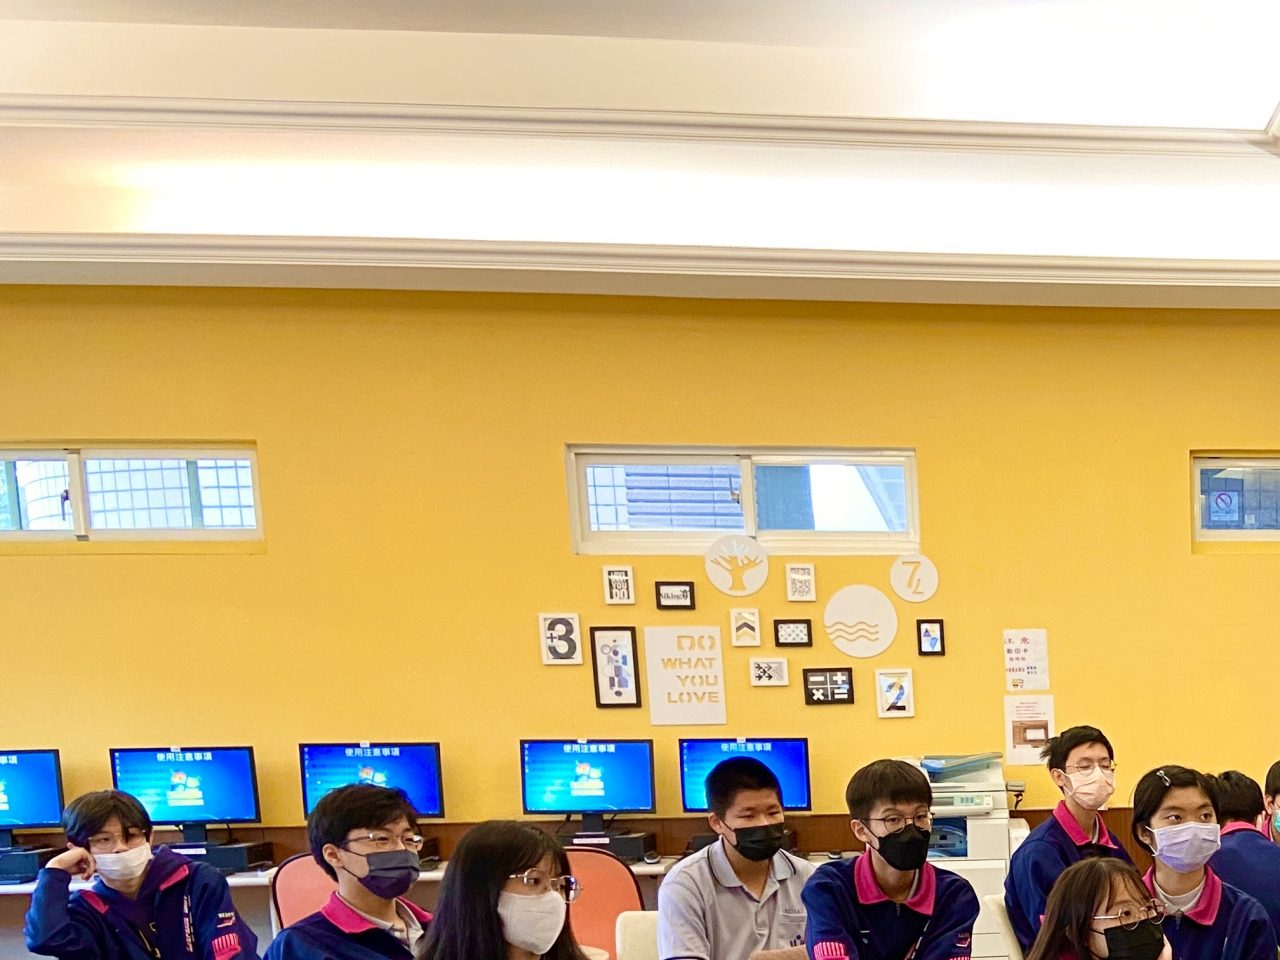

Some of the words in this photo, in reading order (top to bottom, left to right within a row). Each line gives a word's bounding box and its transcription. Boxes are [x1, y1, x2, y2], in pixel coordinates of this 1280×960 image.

[677, 635, 716, 651] DO
[661, 657, 716, 670] WHAT
[676, 675, 718, 687] YOU
[667, 691, 719, 704] LOVE
